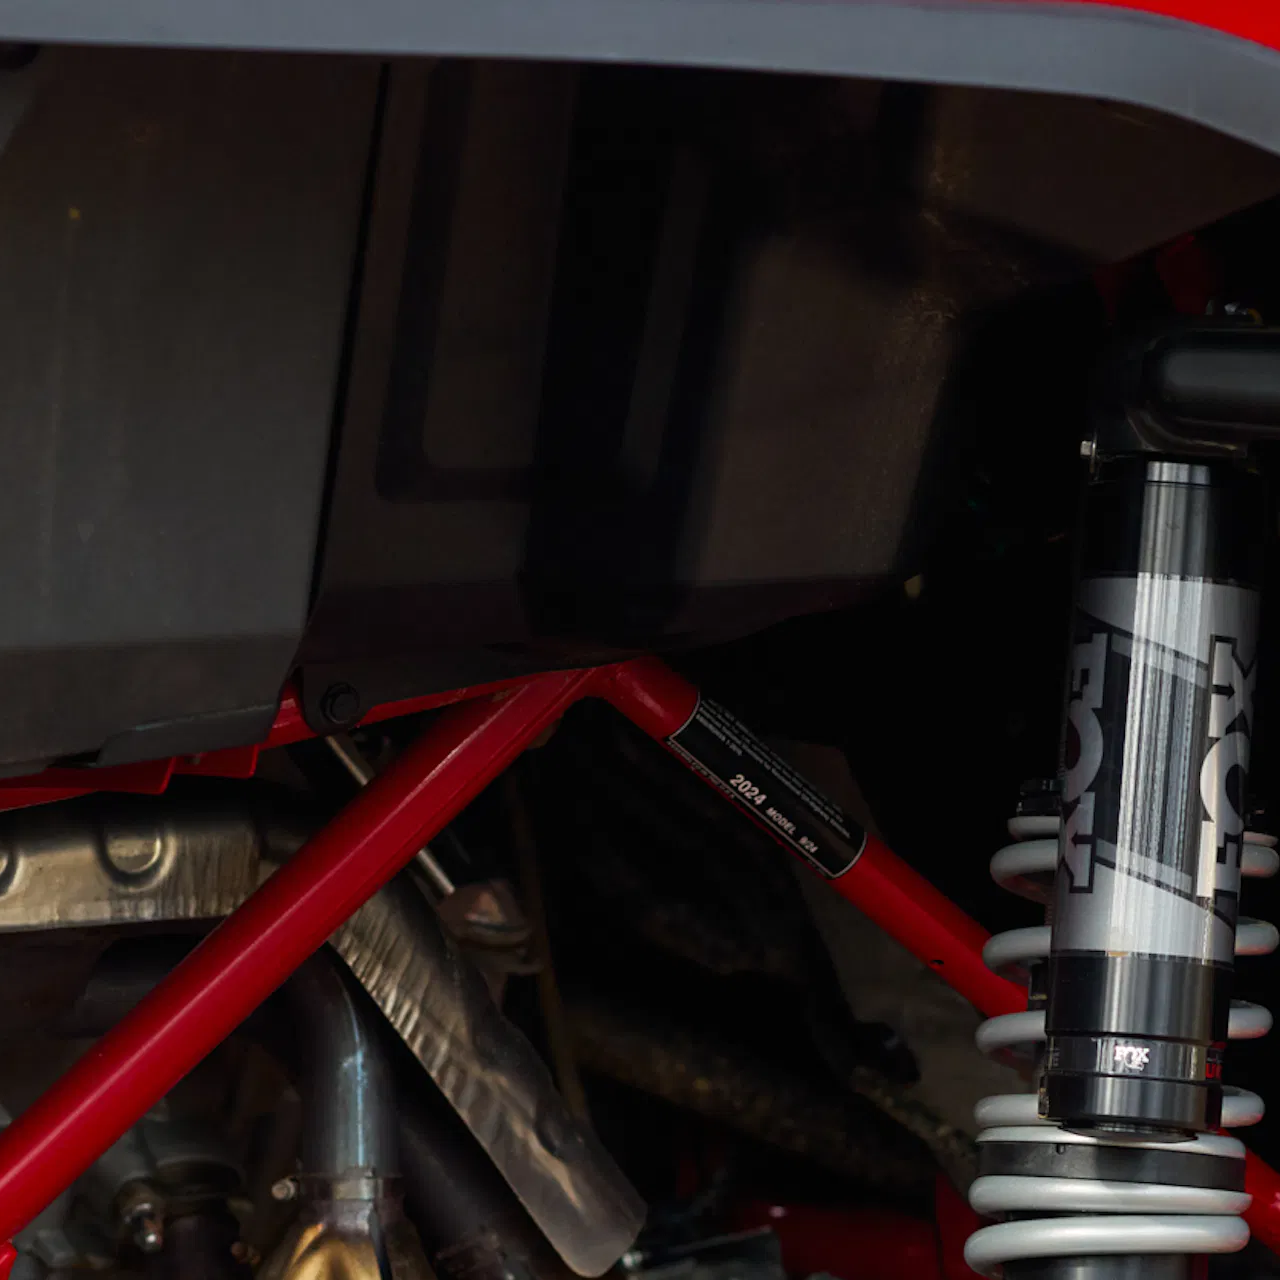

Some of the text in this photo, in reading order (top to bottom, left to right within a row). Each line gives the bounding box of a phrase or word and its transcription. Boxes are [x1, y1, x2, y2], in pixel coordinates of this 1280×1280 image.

[729, 773, 767, 805] 2024
[766, 807, 797, 835] MODEL
[1114, 1046, 1150, 1070] FOX
